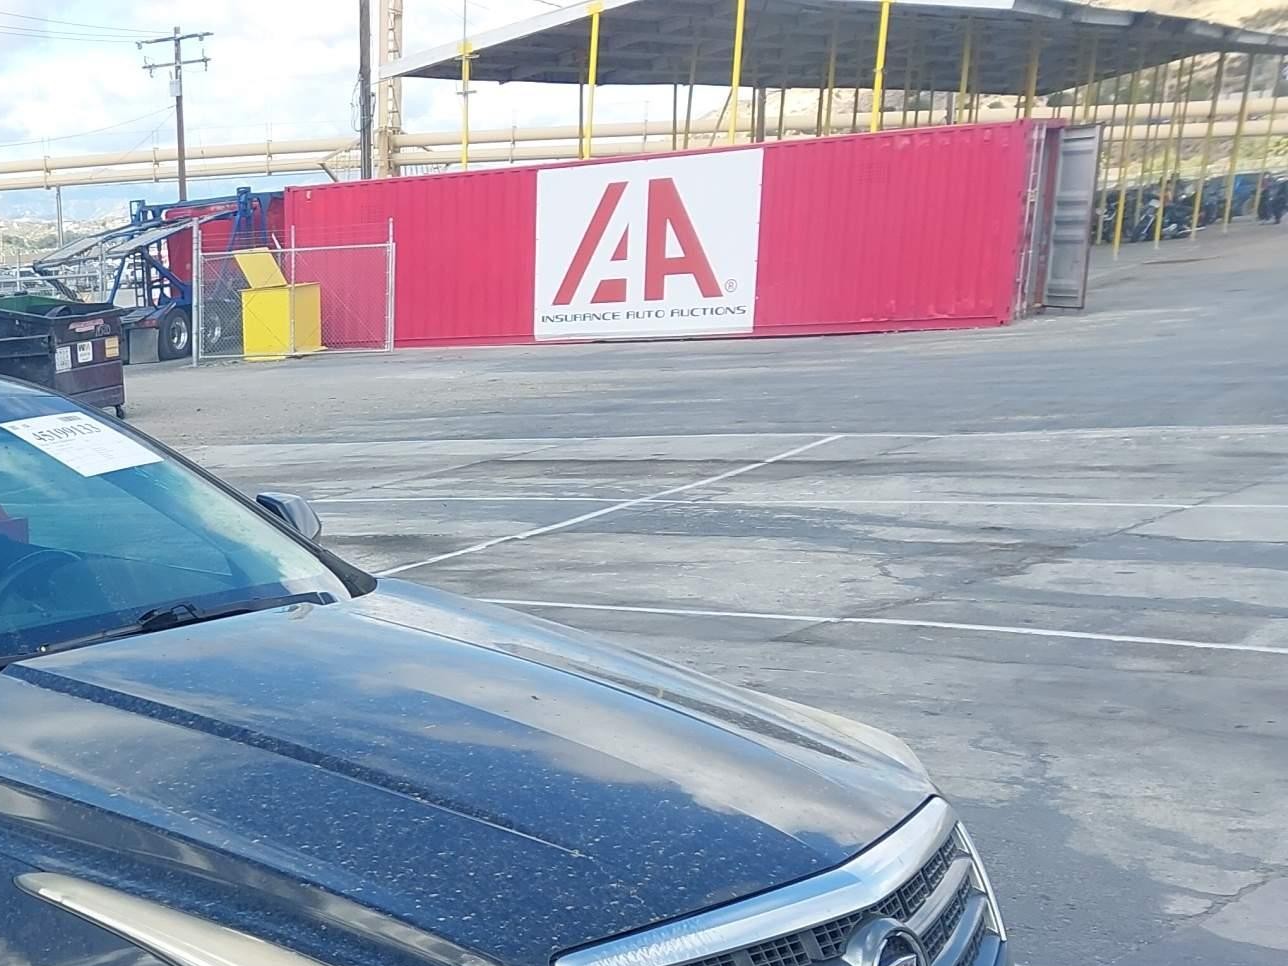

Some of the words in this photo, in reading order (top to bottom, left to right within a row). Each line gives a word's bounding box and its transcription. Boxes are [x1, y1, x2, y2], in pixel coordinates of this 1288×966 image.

[541, 311, 621, 323] INSURANCE
[625, 309, 666, 320] AUTO
[670, 305, 747, 318] AUCTIONS
[32, 423, 102, 442] 45199133
